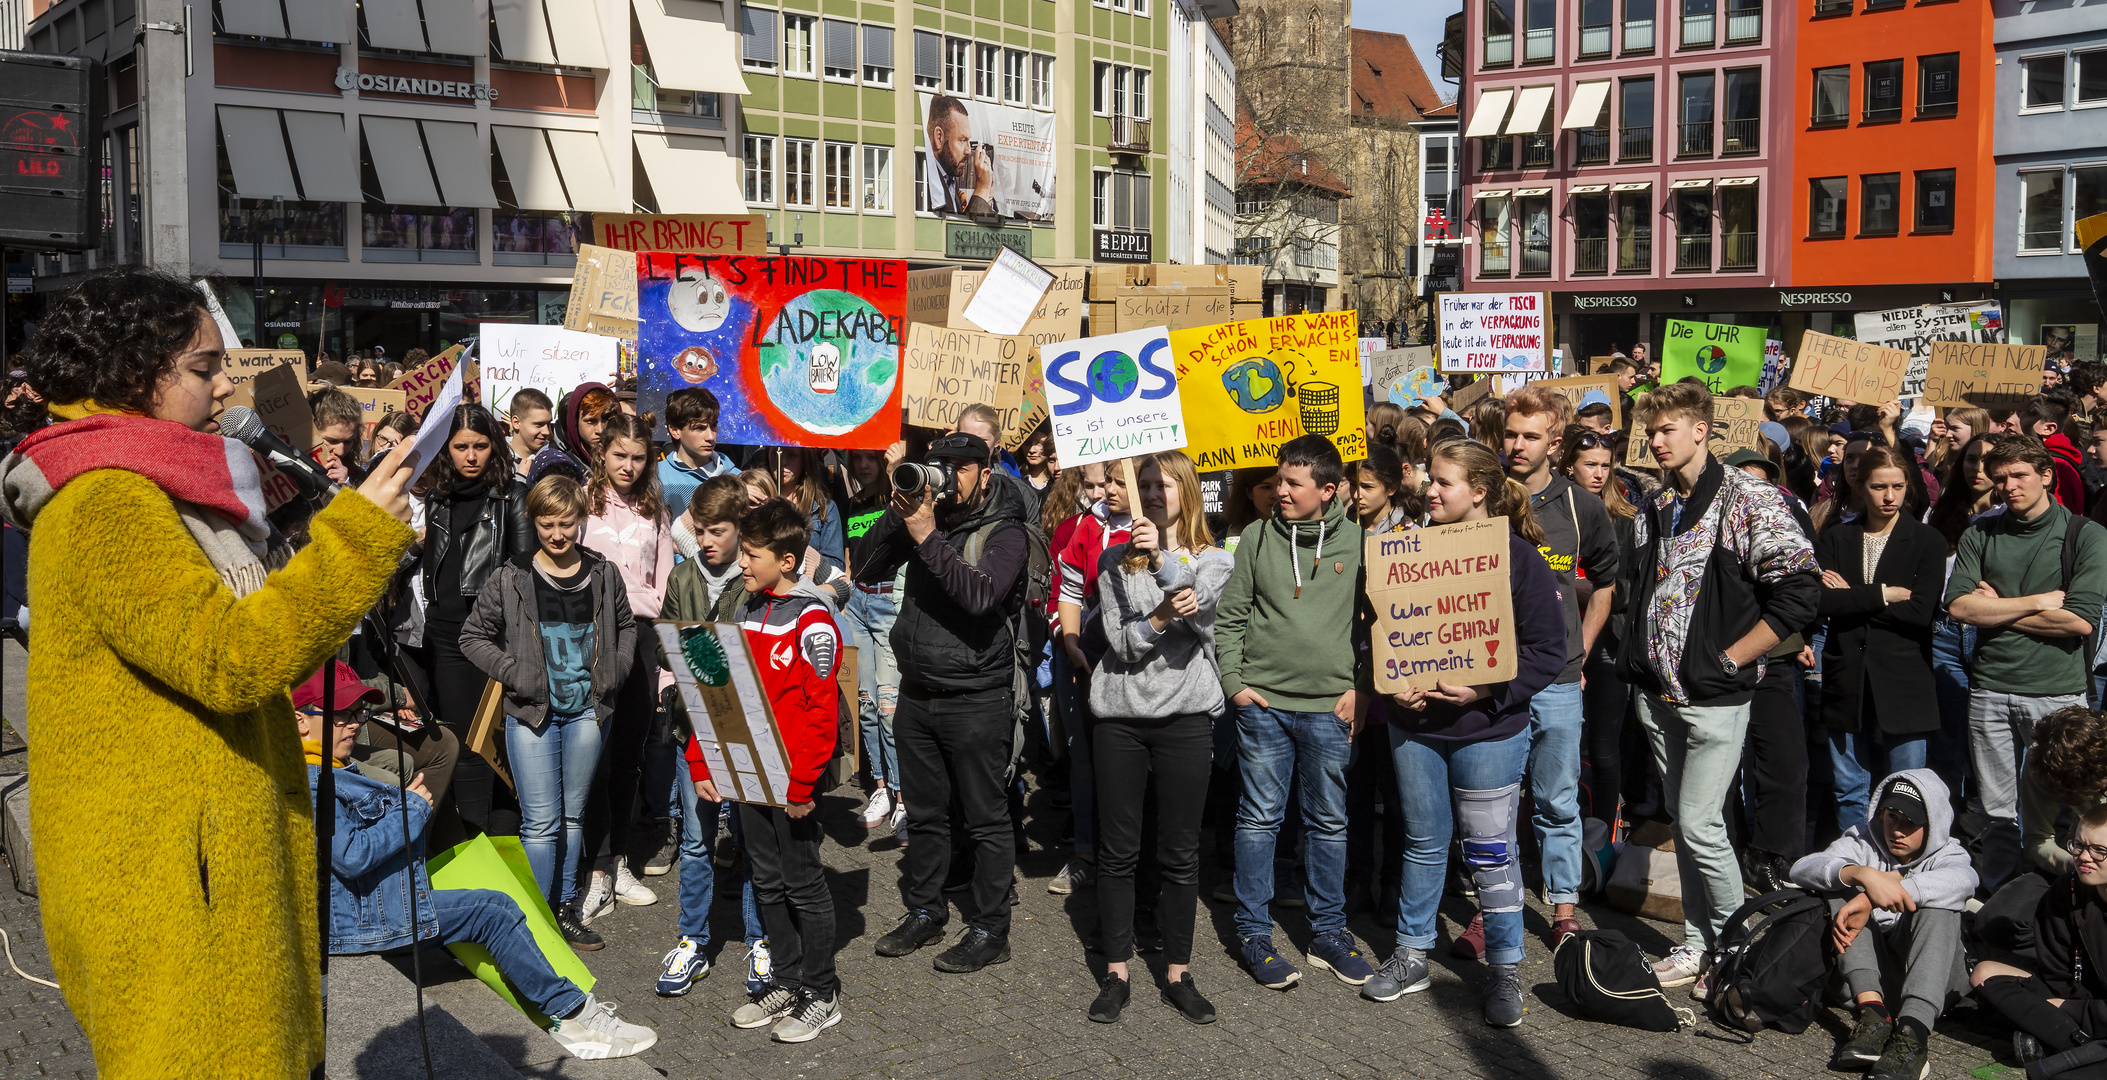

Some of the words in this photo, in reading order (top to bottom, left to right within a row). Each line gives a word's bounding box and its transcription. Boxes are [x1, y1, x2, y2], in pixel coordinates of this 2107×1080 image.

[998, 134, 1052, 153] EXPERTENTAG
[19, 159, 60, 175] LILO
[604, 219, 652, 252] IHR
[954, 229, 1026, 247] SCHLOSSBERG
[1111, 233, 1148, 252] EPPLI
[1110, 252, 1133, 260] SCHÄTZEN
[1133, 252, 1149, 260] WERTE
[646, 254, 748, 287] LET'S
[835, 260, 898, 293] THE
[1205, 297, 1226, 316] die
[1443, 297, 1469, 312] Früher
[1471, 301, 1484, 311] war
[1488, 296, 1503, 311] der
[1509, 295, 1536, 311] FISCH
[1573, 295, 1638, 310] NESPRESSO
[1779, 291, 1852, 307] NESPRESSO
[1054, 301, 1070, 319] for
[1881, 308, 1924, 322] NIEDER
[1935, 306, 1950, 316] mit
[1953, 306, 1971, 315] dem
[751, 306, 906, 348] LADEKABEL
[1445, 319, 1454, 331] in
[1460, 317, 1474, 330] der
[1480, 314, 1540, 330] VERPACKUNG
[1885, 323, 1907, 333] alten
[1914, 314, 1967, 329] SYSTEM
[1930, 326, 1947, 334] eine
[1189, 322, 1248, 364] DACHTE
[1269, 317, 1296, 335] IHR
[1442, 335, 1462, 349] heute
[1464, 336, 1474, 348] ist
[1475, 335, 1487, 348] die
[1490, 333, 1541, 350] VERPACKUNG
[1670, 321, 1694, 339] Die
[1705, 324, 1740, 344] UHR
[498, 338, 528, 358] Wir
[541, 340, 590, 361] sitzen
[931, 331, 987, 355] WANT
[994, 337, 1016, 360] TO
[1211, 335, 1258, 368] SCHON
[1366, 341, 1378, 353] NO
[1805, 332, 1853, 360] THERE
[1854, 345, 1871, 363] IS
[1878, 350, 1903, 371] NO
[239, 353, 276, 367] want
[811, 354, 838, 368] LOW
[909, 348, 948, 372] SURF
[951, 355, 965, 375] IN
[971, 359, 1021, 385] WATER
[1407, 360, 1416, 372] B
[1447, 355, 1460, 368] im
[1466, 352, 1497, 369] FISCH
[1931, 342, 1997, 367] MARCH
[2004, 346, 2046, 372] NOW
[394, 356, 453, 397] ARCH
[487, 361, 520, 381] nach
[1046, 338, 1177, 416] SOS
[1973, 369, 1988, 379] OR
[936, 376, 973, 396] NOT
[979, 383, 995, 404] IN
[1925, 376, 1974, 404] SWIM
[383, 402, 394, 413] is
[1055, 422, 1073, 437] Es
[1086, 416, 1105, 432] ist
[1116, 412, 1169, 428] unsere
[1201, 480, 1221, 492] PARK
[1202, 491, 1219, 502] WAY
[1203, 501, 1224, 513] RIVE
[1380, 533, 1422, 557] mit
[1387, 553, 1500, 585] ABSCHALTEN
[1437, 592, 1492, 615] NICHT
[1388, 631, 1433, 648] euer
[1438, 617, 1500, 645] GEHIRN
